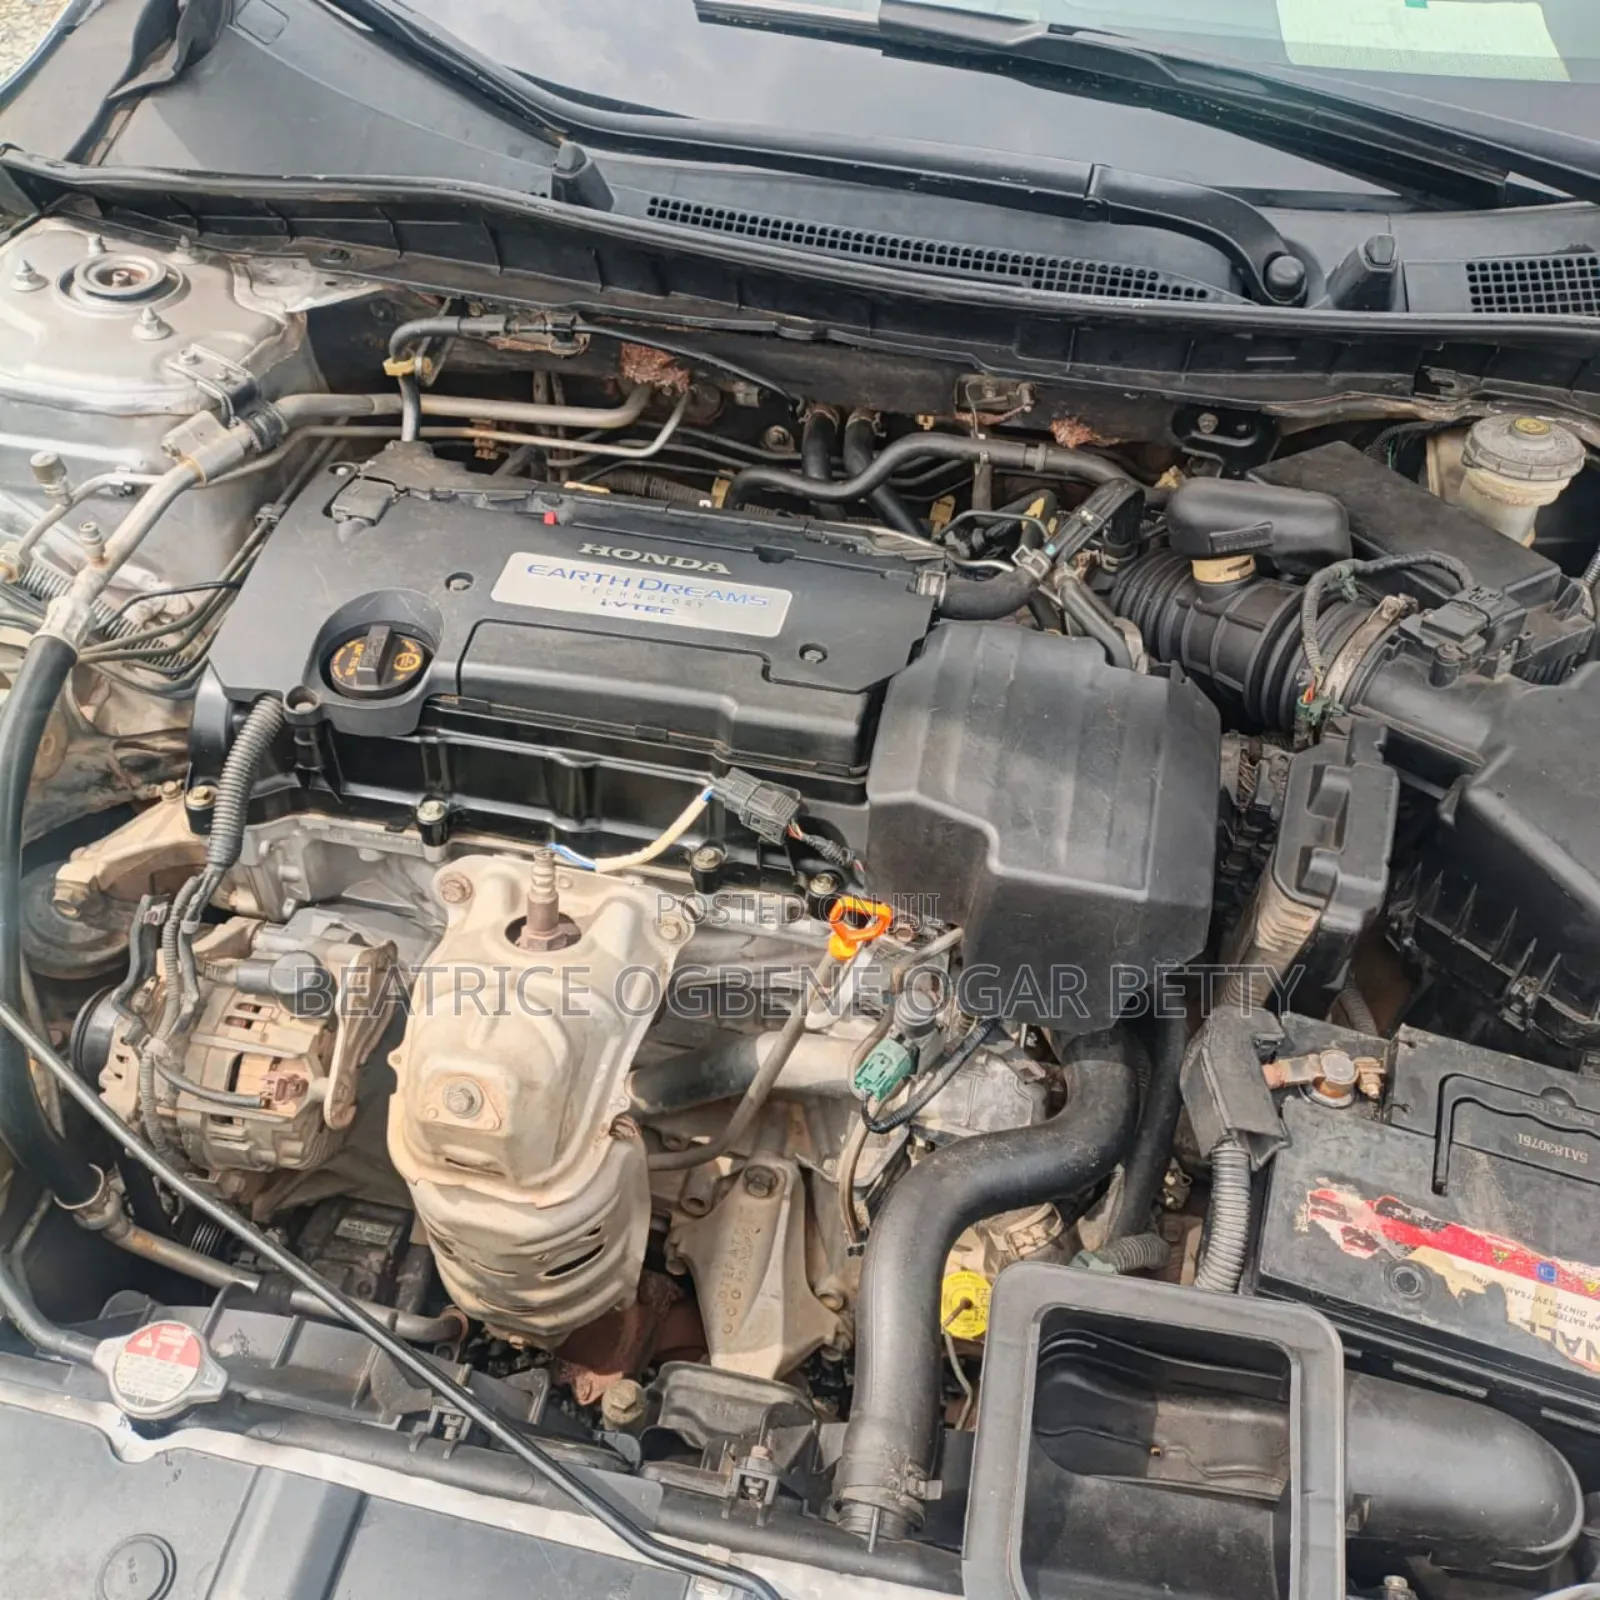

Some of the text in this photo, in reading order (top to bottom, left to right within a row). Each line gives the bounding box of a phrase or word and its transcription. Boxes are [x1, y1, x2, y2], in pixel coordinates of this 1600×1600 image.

[578, 543, 732, 575] HONDA
[527, 563, 768, 607] EARTH DREAMS
[580, 584, 705, 607] TECHNOLOGY
